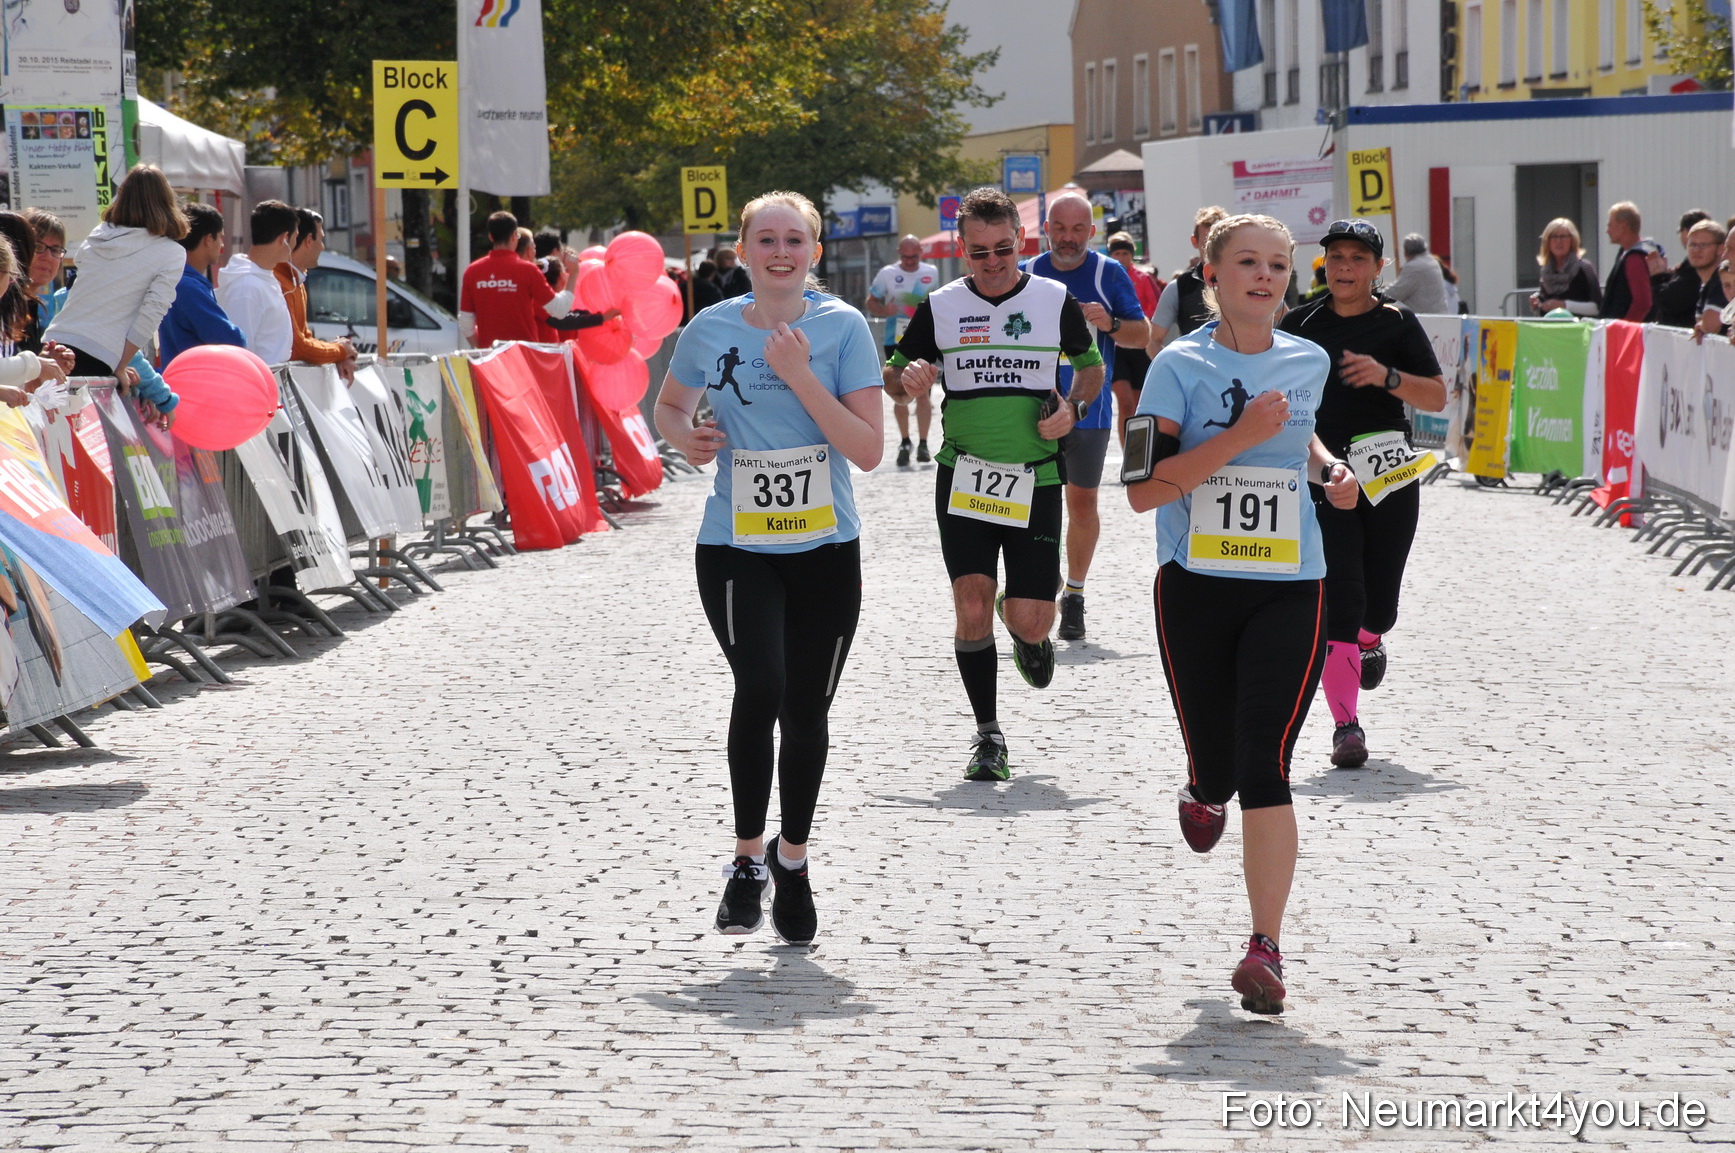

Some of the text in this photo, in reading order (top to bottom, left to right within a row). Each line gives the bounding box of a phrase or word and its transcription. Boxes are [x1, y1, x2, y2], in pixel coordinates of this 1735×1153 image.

[383, 66, 448, 90] Block
[394, 98, 438, 161] C
[9, 125, 19, 169] Sukkulenten
[1352, 150, 1387, 165] Block
[1251, 162, 1281, 170] DAHMIT
[12, 171, 21, 195] andere
[687, 169, 721, 182] Block
[1360, 169, 1383, 202] D
[1253, 187, 1302, 201] DAHMIT
[695, 187, 716, 219] D
[959, 335, 991, 344] OBI
[956, 355, 1041, 370] Laufteam
[973, 371, 1022, 384] Fürth
[1295, 389, 1312, 402] HIP
[1348, 445, 1374, 459] PARTL
[734, 455, 813, 469] PARTL Neumarkt
[959, 455, 982, 467] PARTL
[1367, 447, 1417, 478] 252
[971, 468, 1020, 498] 127
[1201, 475, 1285, 490] ARTL Neumarkt
[1383, 467, 1418, 485] Angela
[753, 469, 812, 508] 337
[969, 498, 1011, 516] Stephan
[1216, 491, 1279, 533] 191
[766, 516, 807, 531] Katrin
[1220, 540, 1271, 558] Sandra
